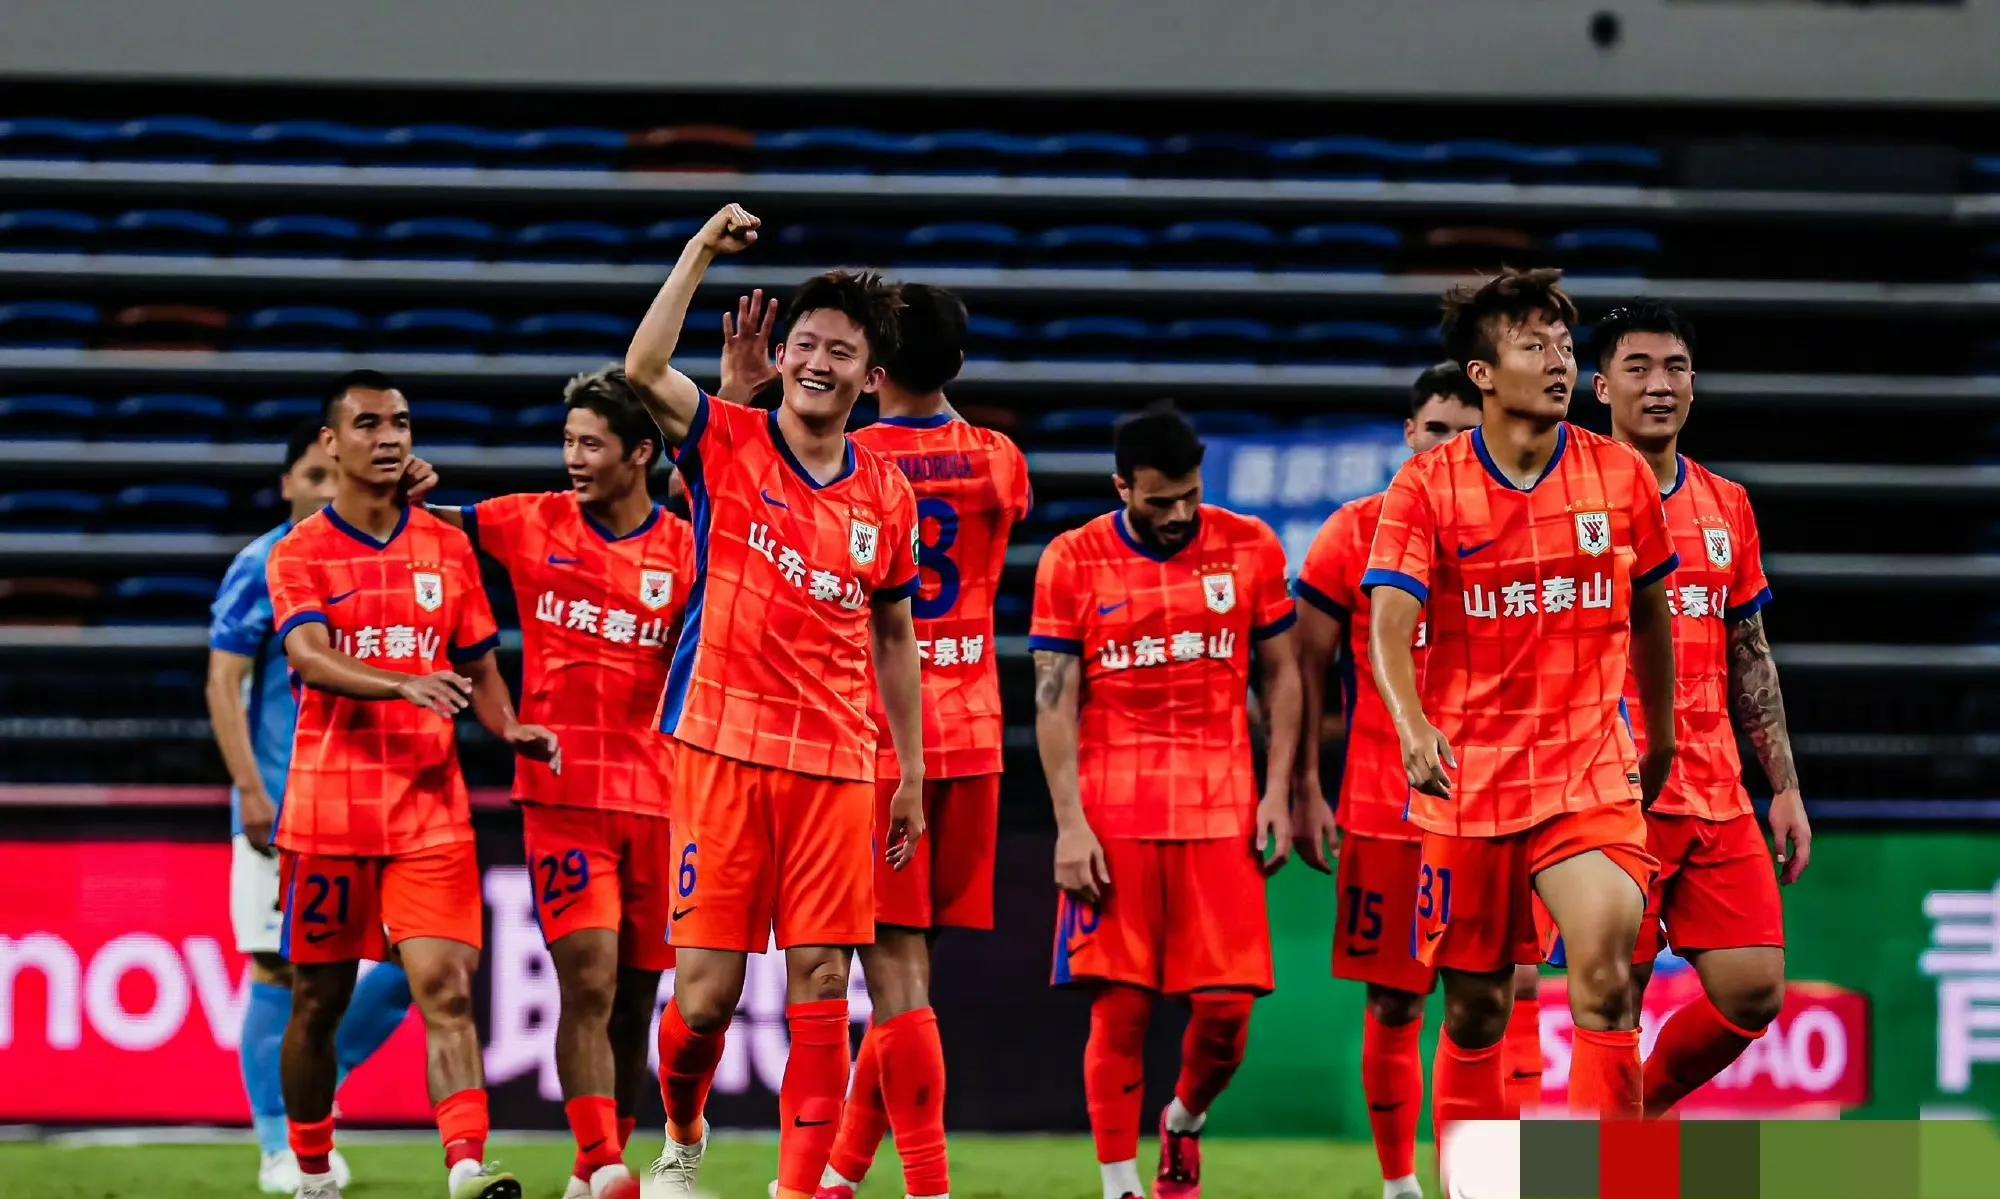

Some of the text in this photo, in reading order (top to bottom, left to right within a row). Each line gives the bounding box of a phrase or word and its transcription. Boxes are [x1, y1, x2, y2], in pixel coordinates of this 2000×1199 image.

[748, 521, 864, 610] 山东泰山
[535, 591, 670, 648] 山东泰山
[1463, 572, 1613, 619] 山东泰山
[1097, 627, 1236, 669] 山东泰山
[540, 848, 591, 903] 29
[678, 842, 698, 898] 6
[1418, 863, 1452, 925] 31
[302, 874, 352, 925] 21
[1346, 885, 1384, 940] 15
